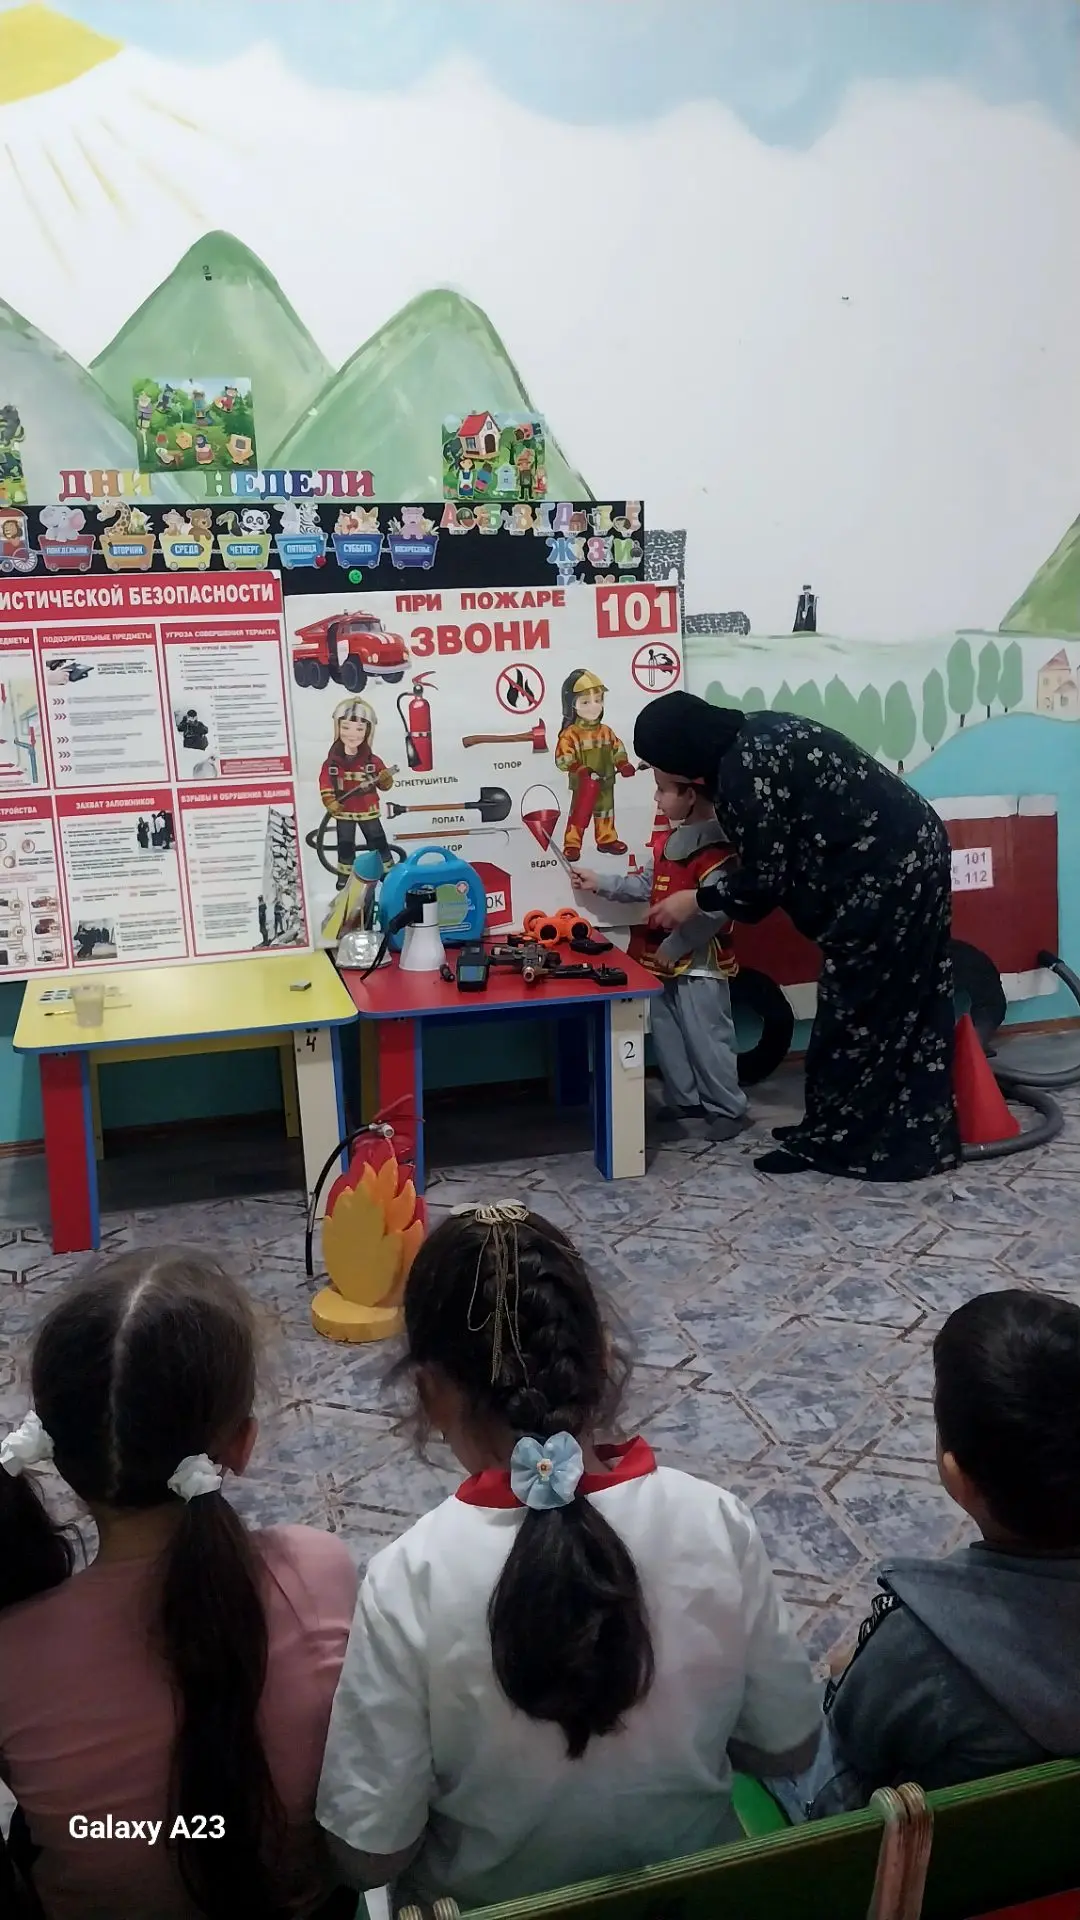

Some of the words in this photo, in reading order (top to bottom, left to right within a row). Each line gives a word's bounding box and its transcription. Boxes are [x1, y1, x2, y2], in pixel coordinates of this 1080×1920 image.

[59, 469, 151, 501] ДНИ
[205, 469, 375, 500] НЕДЕЛИ
[113, 545, 144, 555] ВТОРНИК
[174, 544, 199, 554] СРЕДА
[230, 545, 259, 555] ЧЕТВЕРГ
[286, 544, 317, 553] ПЯТНИЦА
[343, 544, 373, 553] СУББОТА
[0, 584, 124, 610] ИСТИЧЕСКОЙ
[129, 584, 274, 607] БЕЗОПАСНОСТИ
[396, 594, 442, 612] ПРИ
[460, 590, 566, 610] ПОЖАРЕ
[601, 591, 677, 632] 101
[42, 633, 112, 644] ПОДОЗРИТЕЛЬНЫЕ
[112, 632, 153, 641] ПРЕДМЕТЫ
[165, 631, 193, 639] УГРОЗА
[195, 629, 244, 638] СОВЕРШЕНИЯ
[246, 628, 277, 636] ТЕРАКТА
[410, 619, 551, 657] ЗВОНИ
[493, 761, 522, 770] ТОПОР
[394, 776, 459, 787] ОГНЕТУШИТЕЛЬ
[181, 793, 211, 803] ВЗРЫВЫ
[219, 791, 262, 801] ОБРУШЕНИЯ
[263, 789, 291, 798] ЗДАНИЙ
[75, 801, 104, 810] ЗАХВАТ
[105, 798, 156, 808] ЗАЛОЖНИКОВ
[0, 806, 38, 816] ТРОЙСТВА
[431, 816, 465, 824] ЛОПАТА
[531, 859, 558, 868] ВЕДРО
[964, 852, 986, 865] 101
[964, 870, 988, 884] 112
[306, 1035, 317, 1053] 4
[623, 1040, 636, 1060] 2
